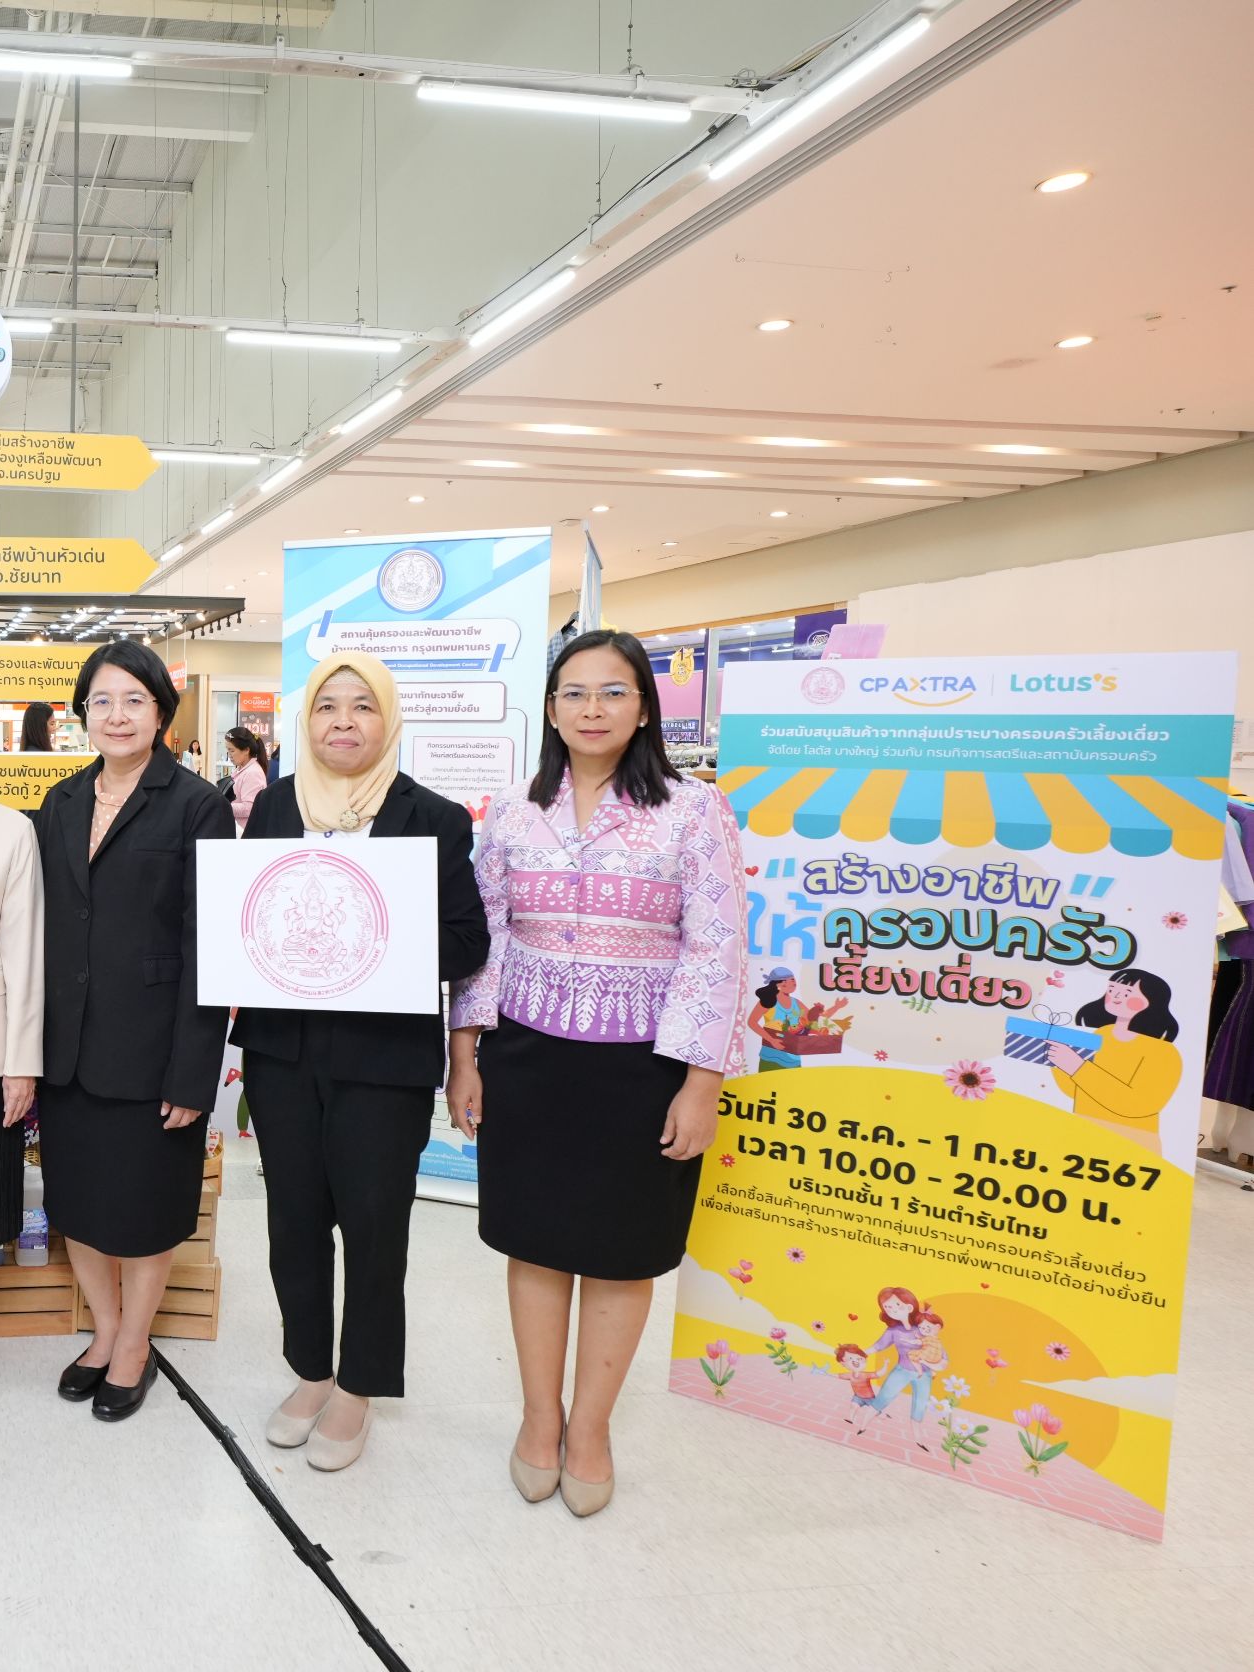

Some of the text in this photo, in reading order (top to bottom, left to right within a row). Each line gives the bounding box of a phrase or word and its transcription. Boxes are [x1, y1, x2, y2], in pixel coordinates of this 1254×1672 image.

[340, 626, 482, 641] สถานคุ้มครองและพัฒนาอาชีพ
[411, 643, 491, 655] กรุงเทพมหานคร
[29, 676, 78, 689] กรุงเทพ
[859, 676, 976, 693] CP AXTRA
[1010, 673, 1117, 693] Lotus's
[401, 701, 479, 715] บครัวสู่ความยั่งยืน
[761, 723, 1170, 742] ร่วมสนับสนุนสินค้าจากกลุ่มเปราะบางครอบครัวเลี้ยงเดี่ยว
[768, 744, 1157, 762] จัดโดย โลตัส บางใหญ่ ร่วมกับ กรมกิจการสตรีและสถาบันครอบครัว
[34, 784, 41, 796] 2
[823, 905, 1137, 971] ครอบครัว
[818, 942, 1032, 1009] เลี้ยงเดี่ยว
[717, 1091, 777, 1125] วันที่
[787, 1107, 827, 1133] 30
[838, 1119, 905, 1148] ส.ค.
[944, 1134, 960, 1157] 1
[973, 1142, 1049, 1173] ก.ย.
[1062, 1154, 1162, 1192] 2567
[737, 1134, 806, 1165] เวลา
[818, 1148, 916, 1185] 10.00
[953, 1172, 1067, 1213] 20.00
[1082, 1197, 1122, 1225] น.
[788, 1177, 1048, 1240] บริเวณชั้น 1 ร้านตำรับไทย
[715, 1183, 1147, 1283] เลือกซื้อสินค้าคุณภาพจากกลุ่มเปราะบางครอบครัวเลี้ยงเดี่ยว
[700, 1197, 1167, 1309] เพื่อส่งเสริมการสร้างรายได้และสามารถพึ่งพาตนเองได้อย่างยั่งยืน
